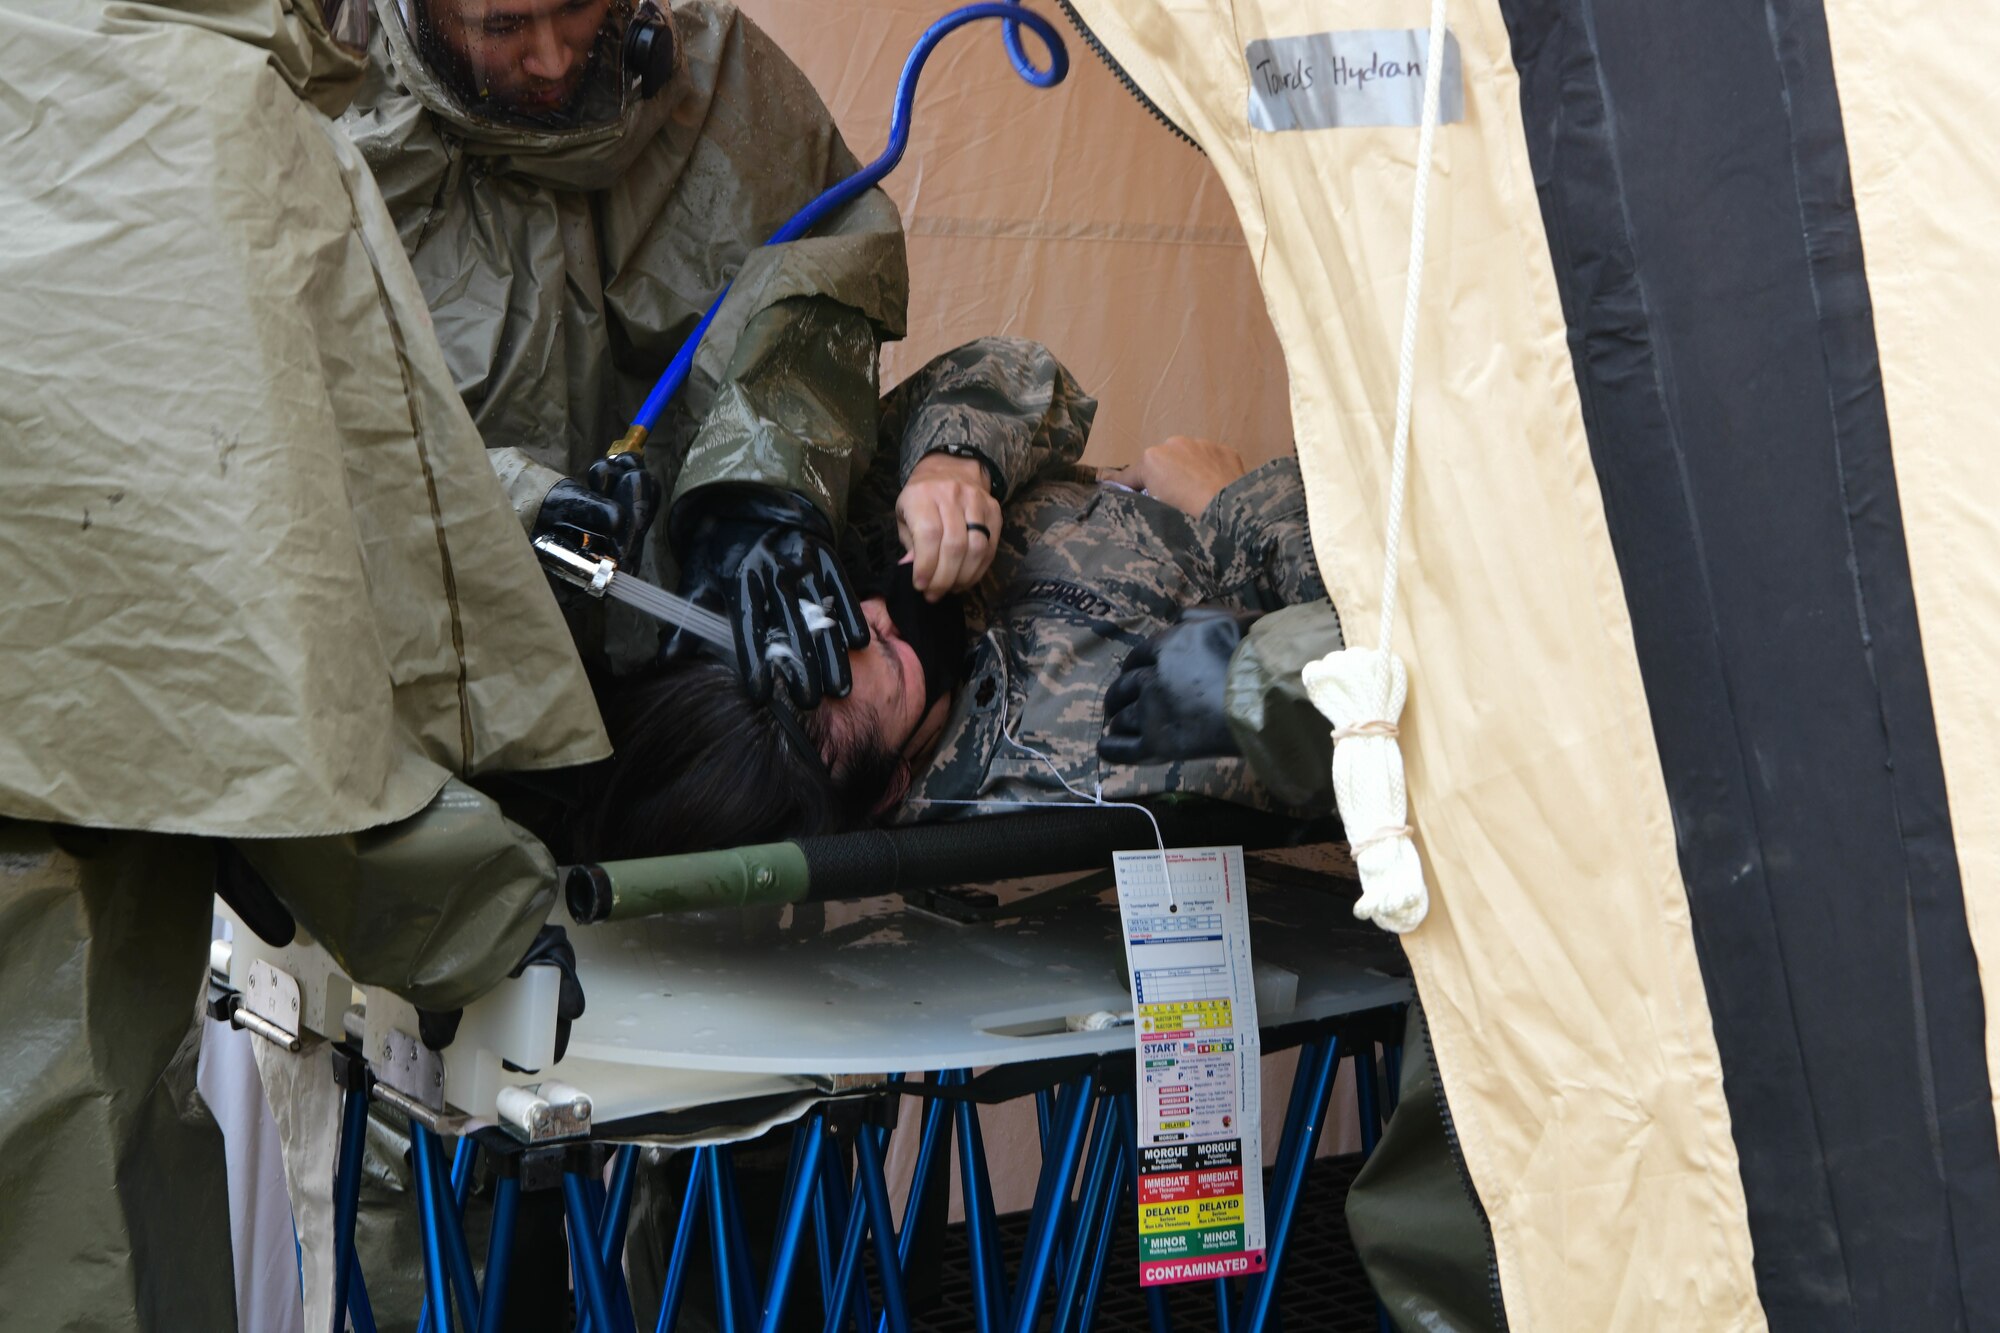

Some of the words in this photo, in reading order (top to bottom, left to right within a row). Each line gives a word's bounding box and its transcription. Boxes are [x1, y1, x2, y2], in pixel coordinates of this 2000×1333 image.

[1332, 52, 1428, 91] Hydran
[1144, 1042, 1177, 1054] START
[1178, 1072, 1184, 1081] P
[1206, 1070, 1214, 1078] M
[1144, 1146, 1189, 1160] MORGUE
[1197, 1141, 1237, 1155] MORGUE
[1144, 1175, 1190, 1189] IMMEDIATE
[1198, 1170, 1239, 1184] IMMEDIATE
[1142, 1194, 1147, 1202] 1
[1196, 1189, 1200, 1197] 1
[1145, 1204, 1190, 1218] DELAYED
[1199, 1199, 1239, 1212] DELAYED
[1150, 1235, 1187, 1250] MINOR
[1203, 1229, 1237, 1244] MINOR
[1145, 1257, 1248, 1281] CONTAMINATED
